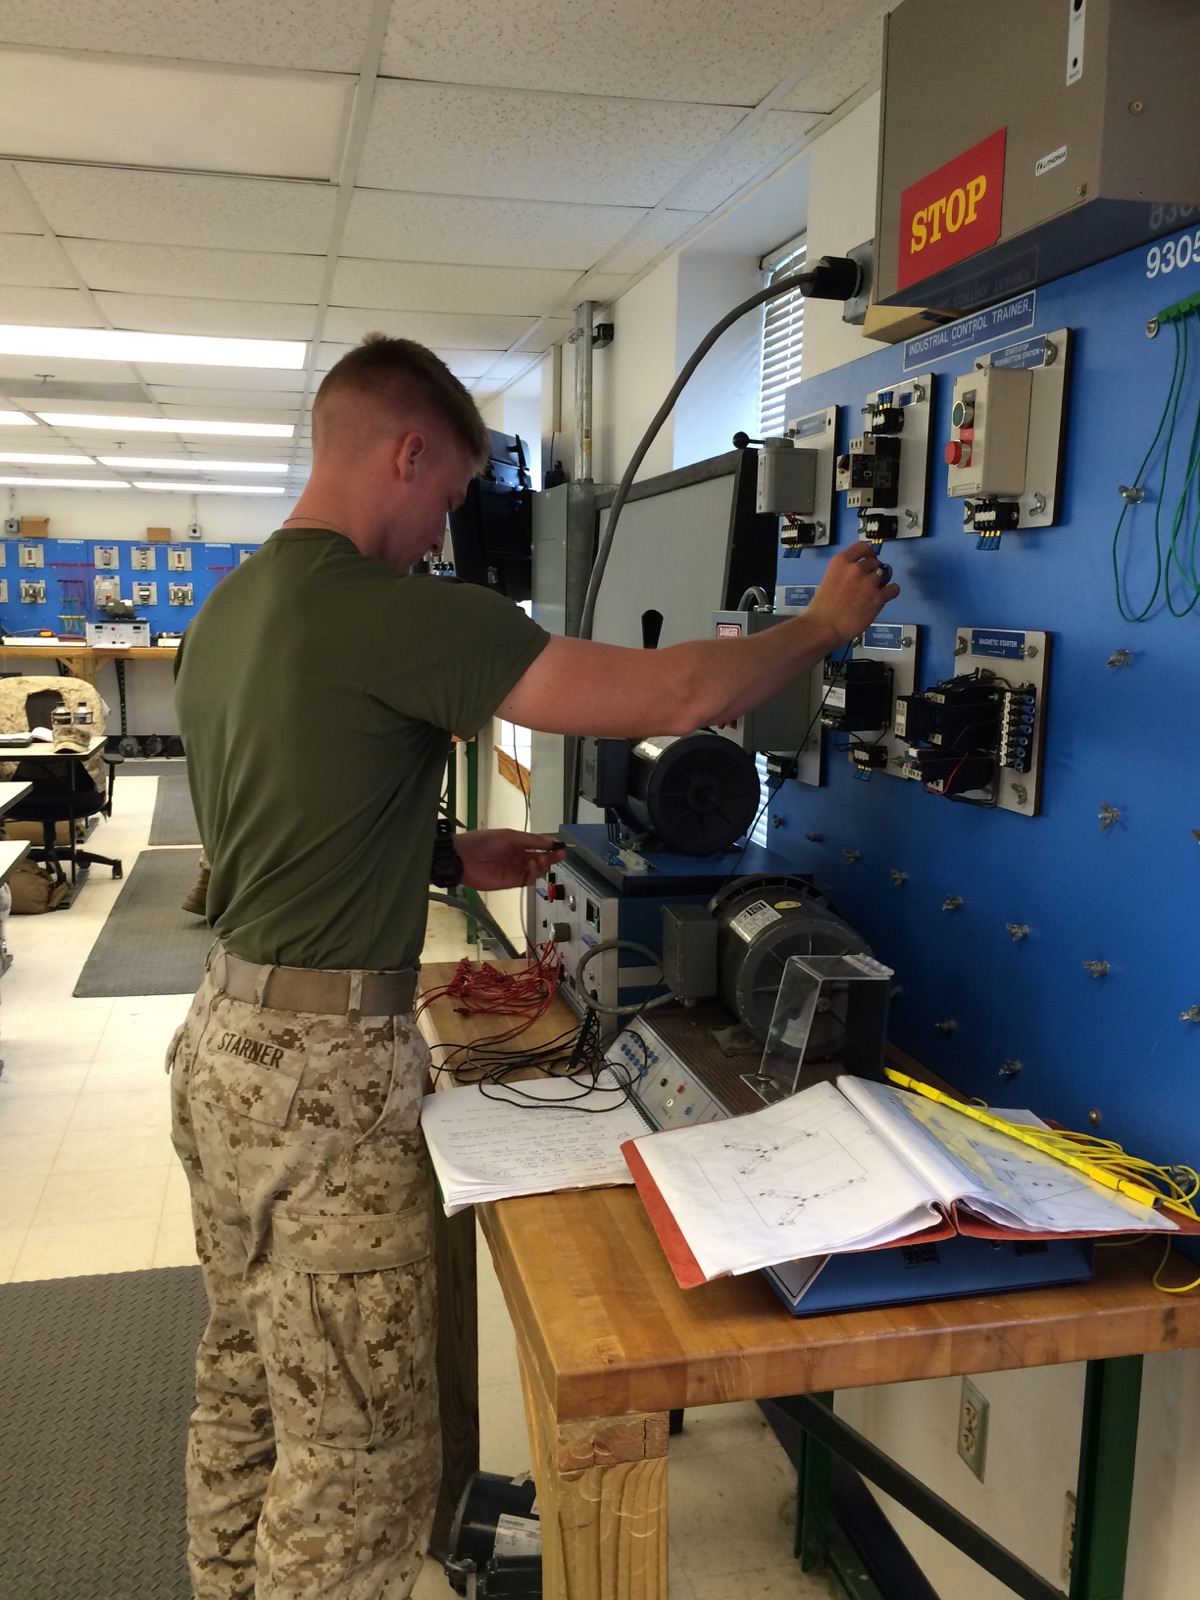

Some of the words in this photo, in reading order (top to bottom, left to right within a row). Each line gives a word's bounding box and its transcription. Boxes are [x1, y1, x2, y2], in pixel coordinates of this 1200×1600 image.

[911, 174, 987, 254] STOP
[908, 332, 949, 357] INDUSTRIAL
[951, 315, 988, 340] CONTROL
[992, 298, 1029, 324] TRAINER
[1022, 347, 1040, 360] STATION
[719, 627, 738, 637] DANGER
[978, 637, 999, 646] MAGNETIC
[999, 639, 1018, 648] STARTER
[217, 1032, 285, 1070] STARNER
